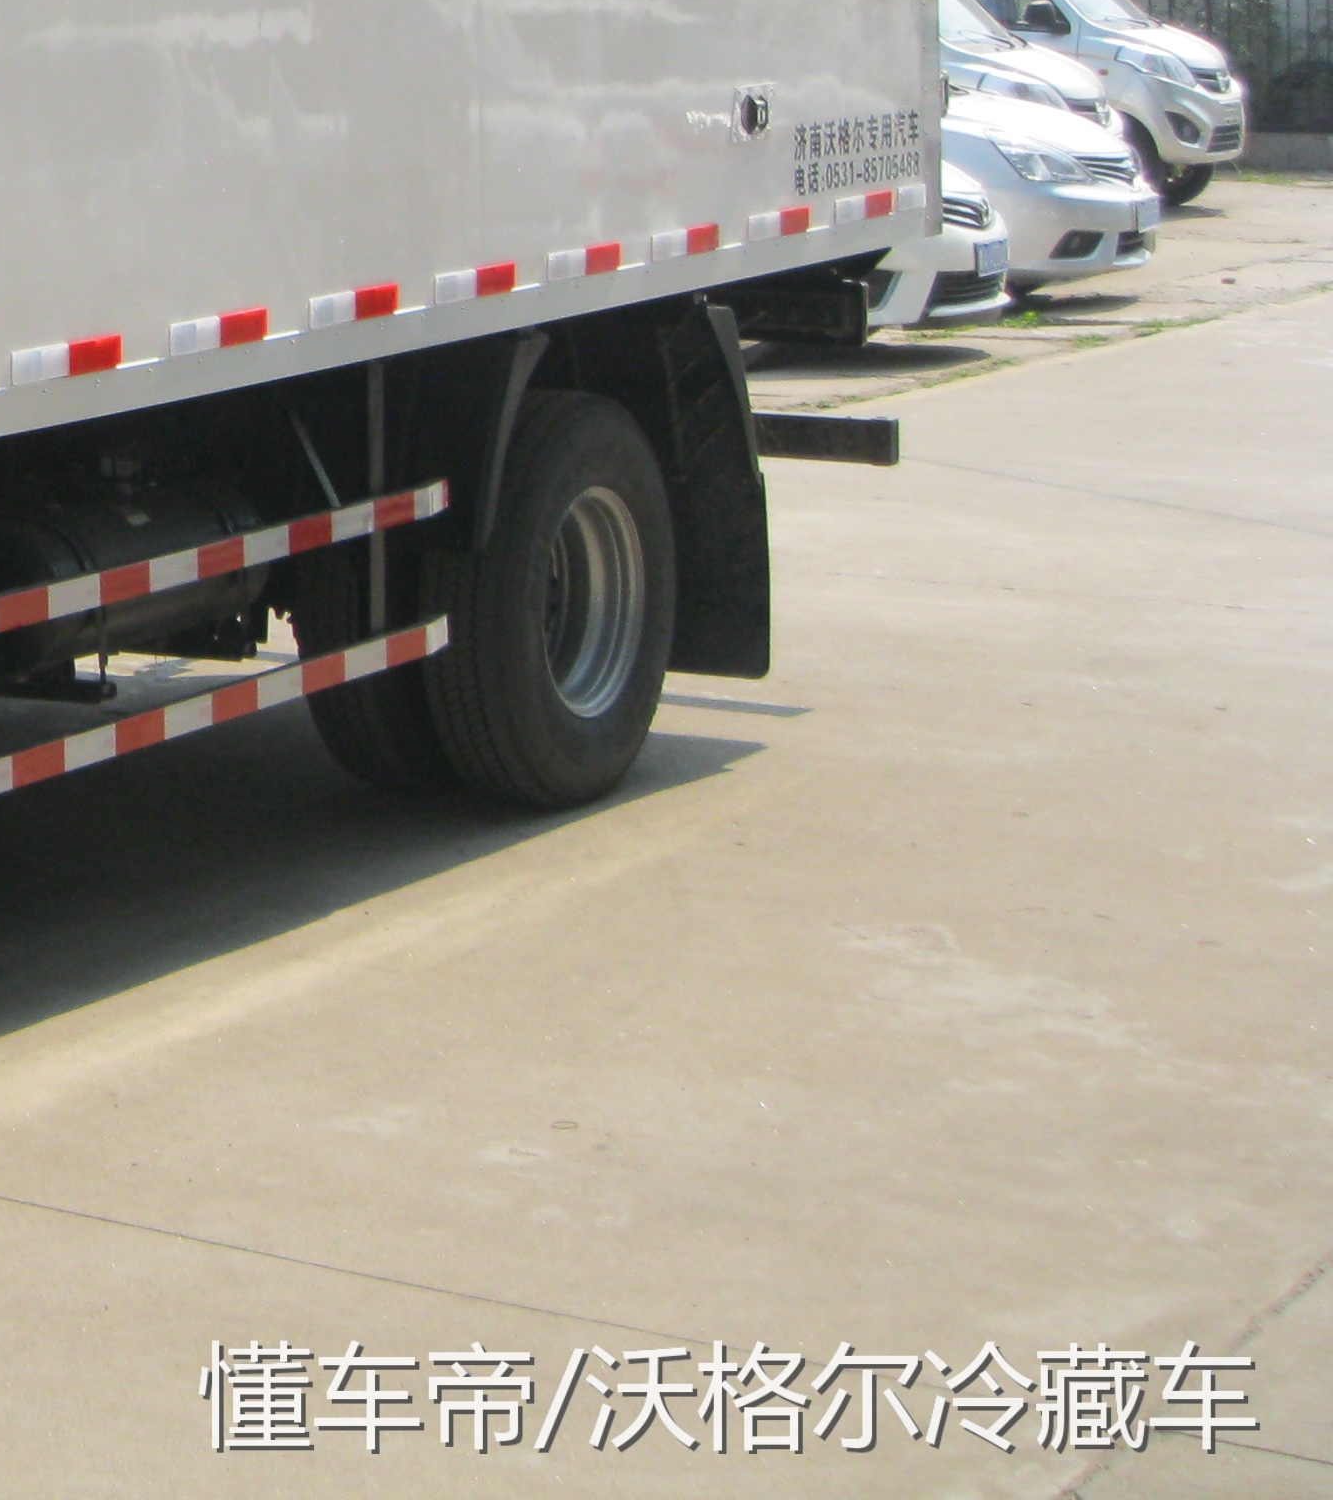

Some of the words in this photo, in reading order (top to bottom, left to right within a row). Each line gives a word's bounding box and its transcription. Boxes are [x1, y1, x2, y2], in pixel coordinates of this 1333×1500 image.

[794, 110, 919, 161] 济南沃格尔专用汽车
